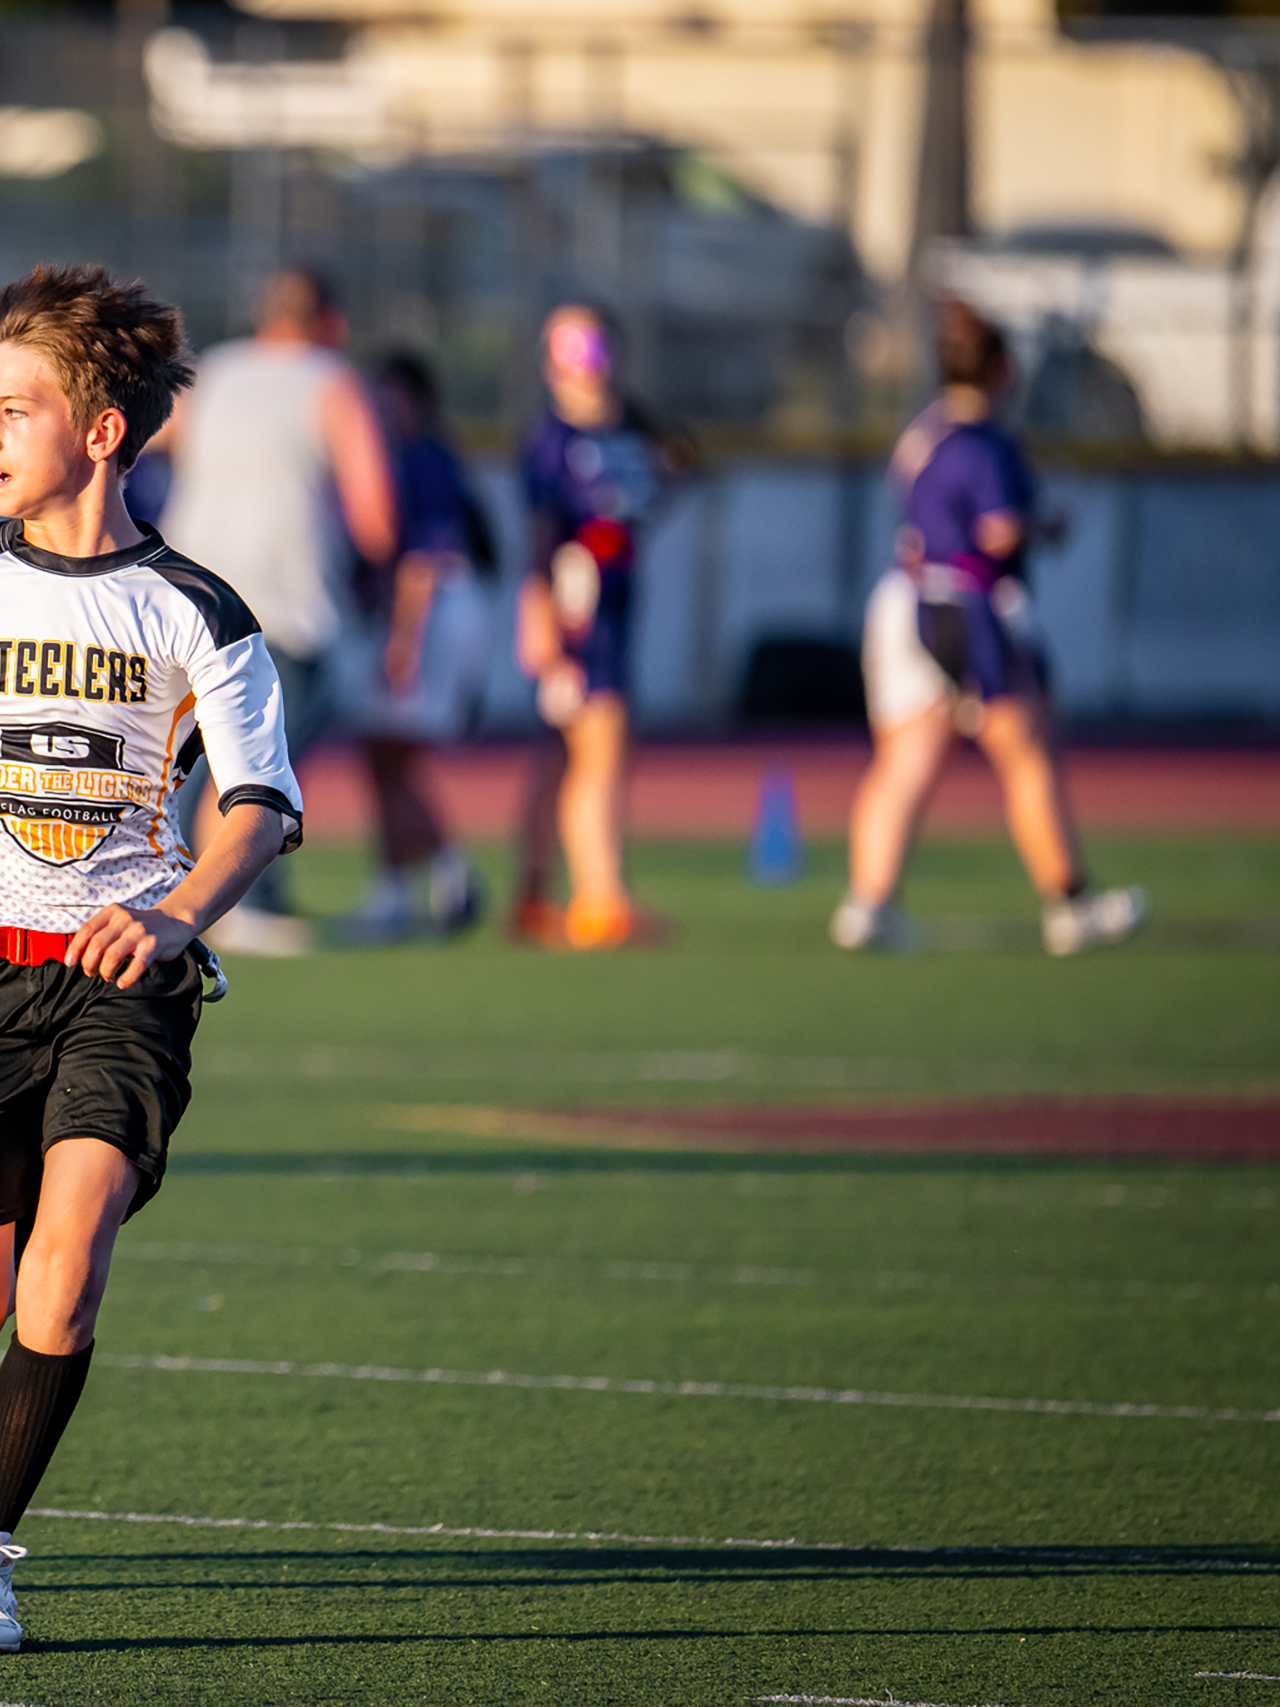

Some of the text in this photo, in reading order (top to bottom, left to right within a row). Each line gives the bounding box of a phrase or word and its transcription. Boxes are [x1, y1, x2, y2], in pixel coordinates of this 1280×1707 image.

[40, 772, 73, 791] THE
[76, 771, 153, 803] LIGHTS
[0, 802, 117, 822] FLAG FOOTBALL
